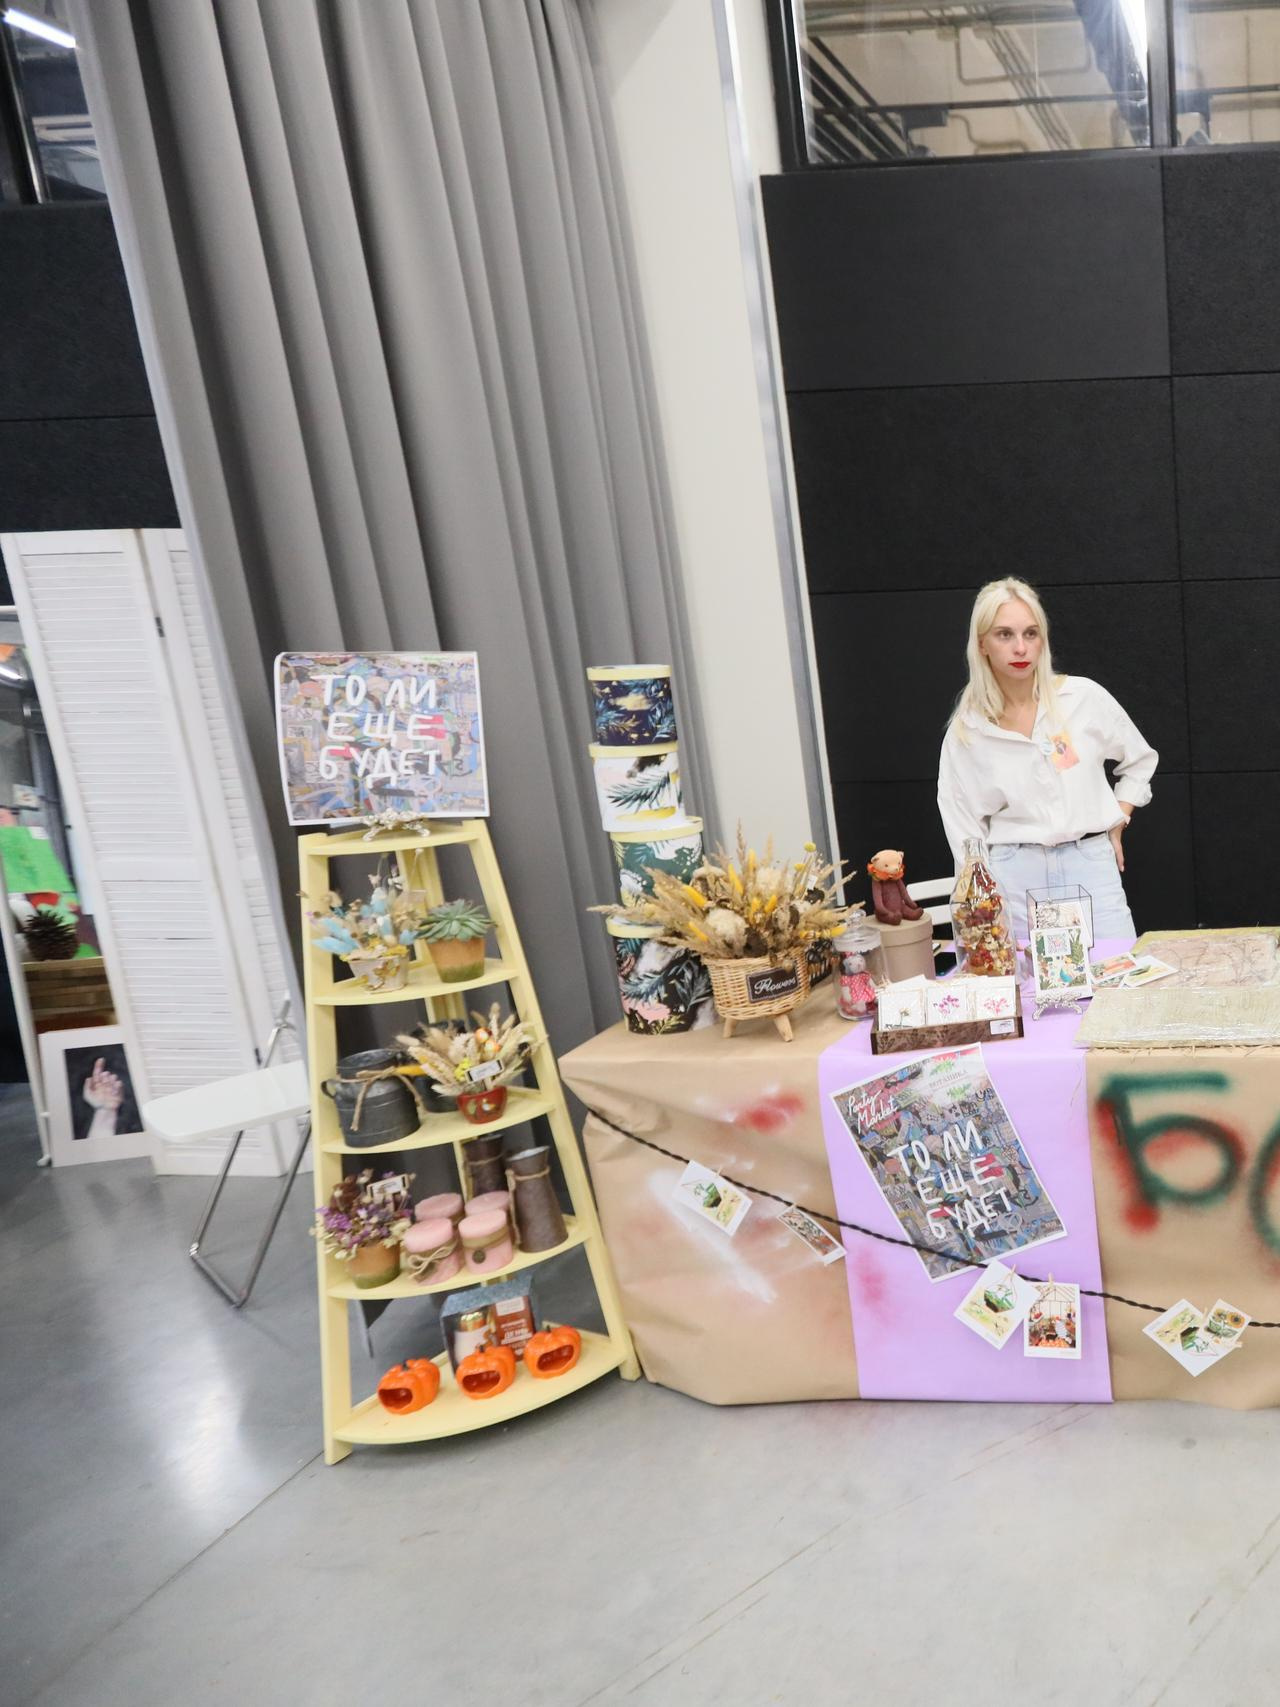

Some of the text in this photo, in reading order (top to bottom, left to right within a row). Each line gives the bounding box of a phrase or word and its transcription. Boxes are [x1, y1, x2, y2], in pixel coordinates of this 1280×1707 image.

[309, 674, 438, 709] ТО ЛИ
[318, 745, 441, 789] БУДЕТ
[848, 1090, 882, 1117] Party
[858, 1095, 899, 1134] Market
[886, 1120, 982, 1177] ТО ЛИ
[926, 1187, 1012, 1239] БУДЕТ
